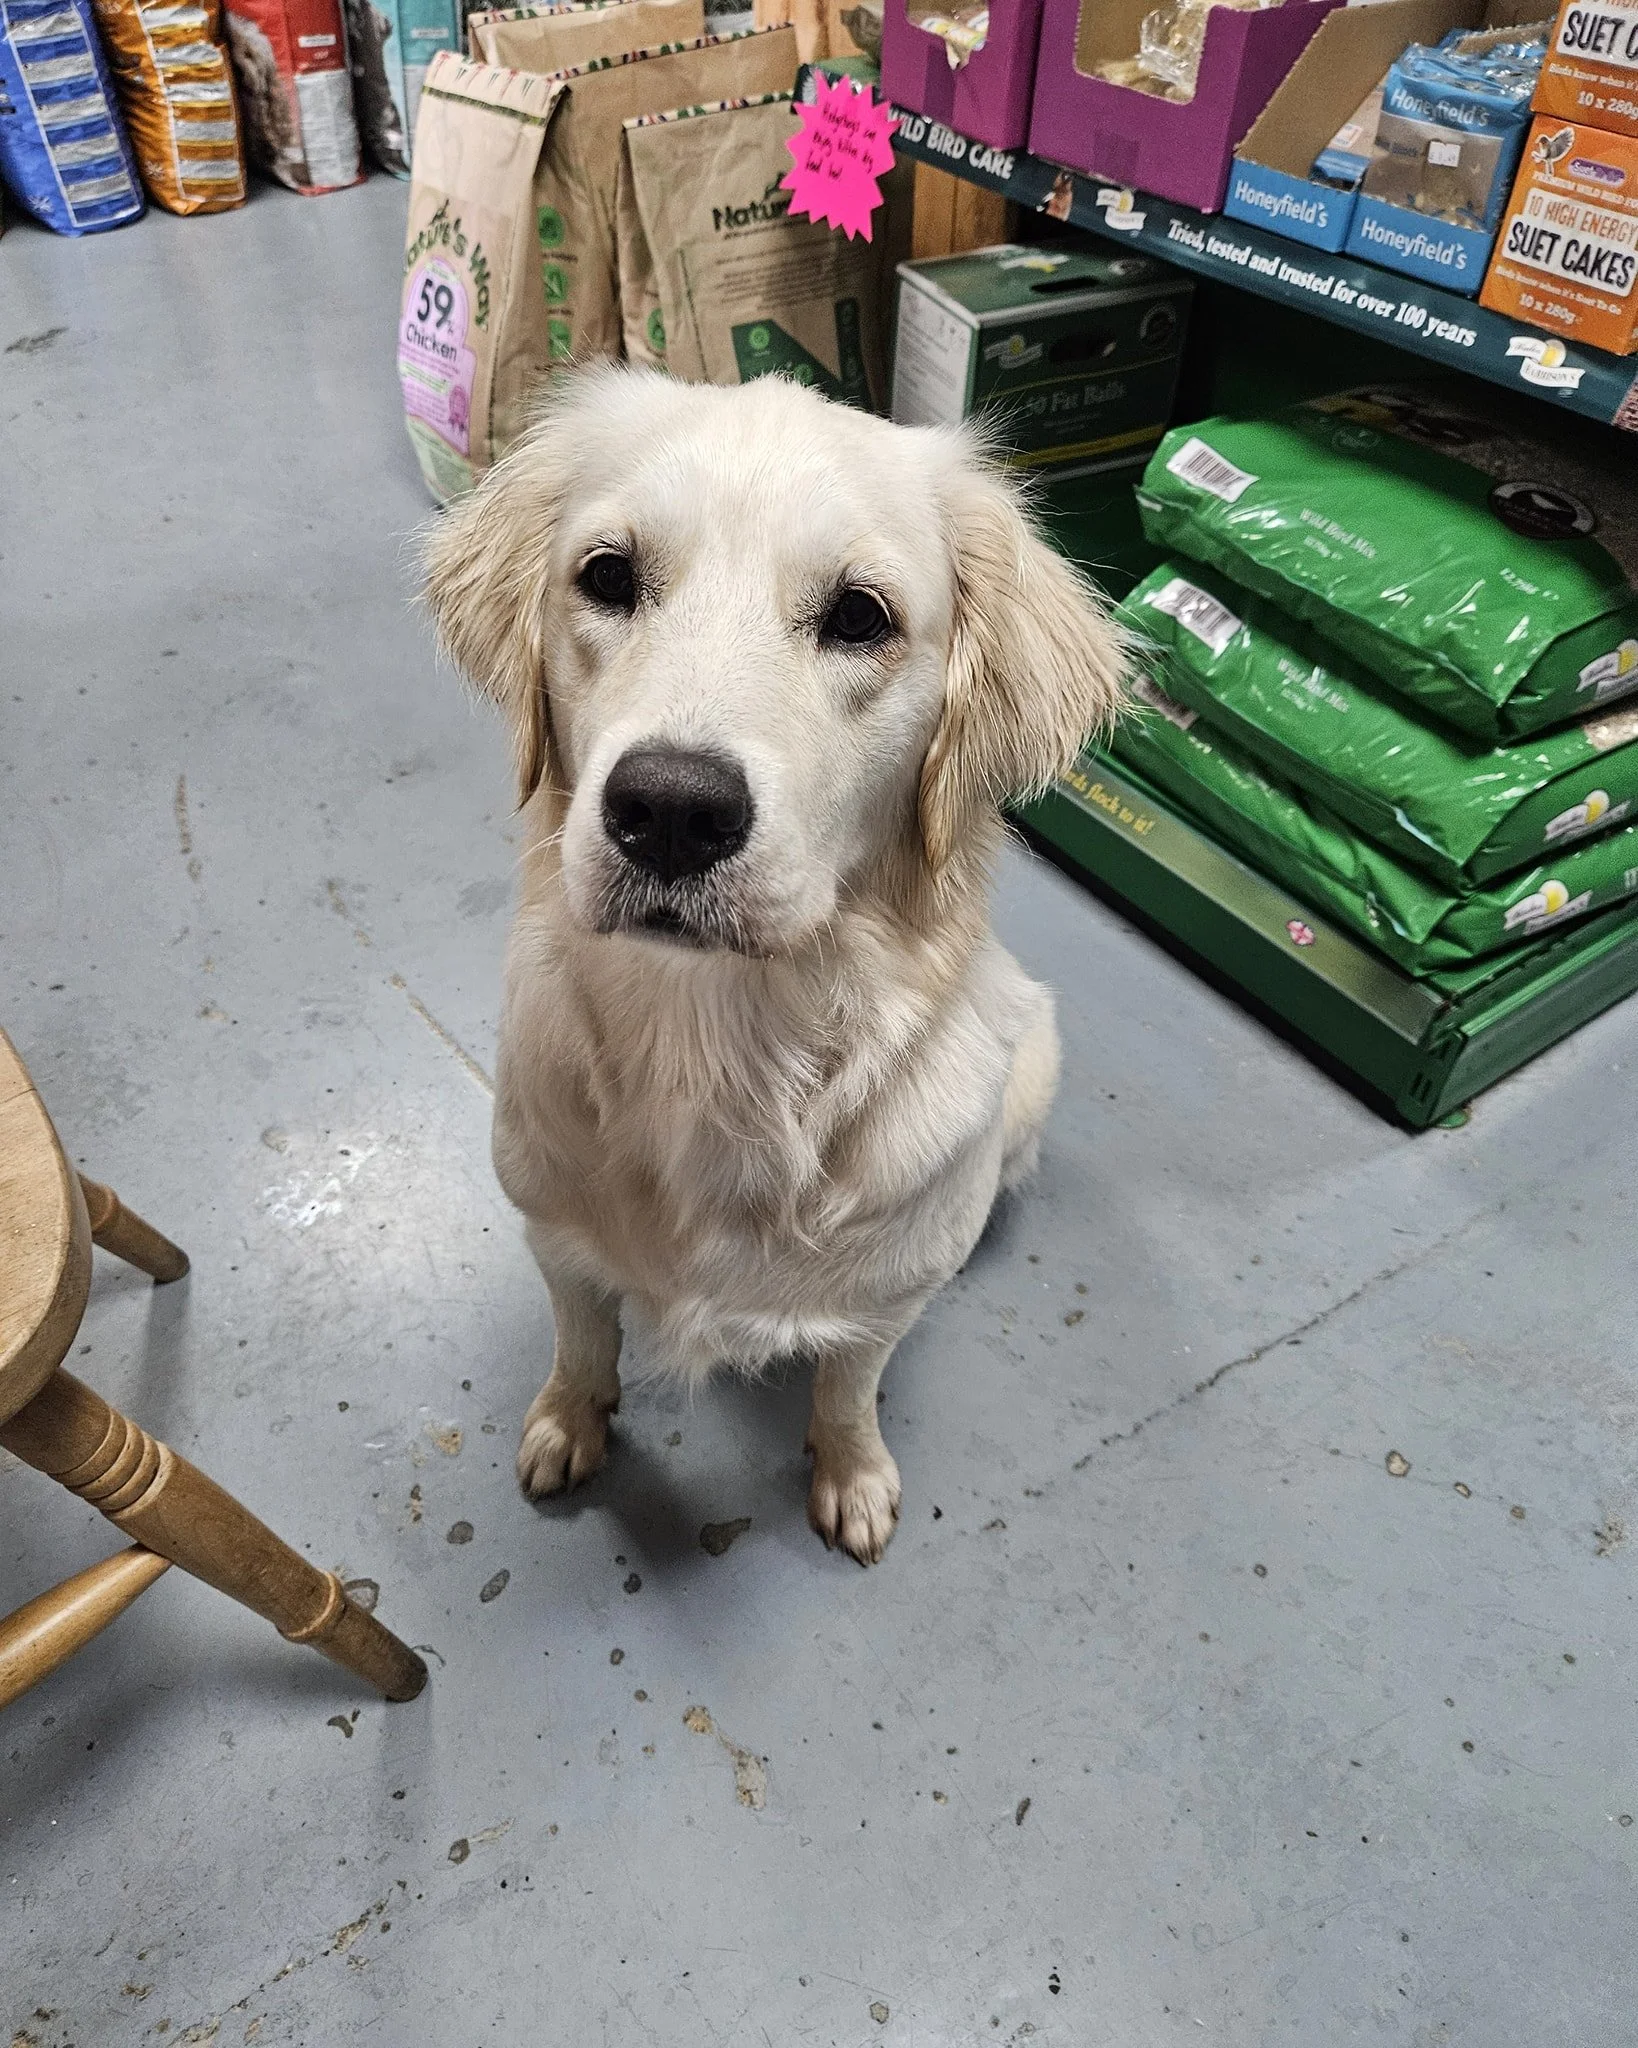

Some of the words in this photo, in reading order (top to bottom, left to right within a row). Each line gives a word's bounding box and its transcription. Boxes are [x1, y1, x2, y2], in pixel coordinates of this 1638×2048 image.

[1563, 10, 1626, 54] SUET
[1391, 88, 1491, 127] Honeyfield's
[1577, 90, 1595, 106] 10
[1595, 97, 1606, 109] x
[887, 107, 925, 143] WILD
[926, 122, 967, 160] BIRD
[968, 143, 1016, 180] CARE
[1234, 179, 1329, 228] Honeyfield's
[1529, 194, 1543, 217] 10
[1544, 198, 1578, 229] HIGH
[1579, 210, 1638, 246] ENERGY
[1360, 217, 1468, 271] Honeyfield's
[1508, 221, 1562, 265] SUET
[1561, 238, 1635, 289] CAKES
[1167, 218, 1205, 253] Tried,
[1206, 236, 1252, 266] tested
[1249, 253, 1282, 277] and
[1278, 261, 1335, 297] trusted
[1331, 278, 1359, 305] for
[1356, 292, 1396, 318] over
[1394, 302, 1428, 329] 100
[1422, 315, 1478, 347] years
[1519, 293, 1534, 309] 10
[1534, 299, 1544, 312] x
[1544, 301, 1577, 325] 280g
[406, 323, 458, 363] Chicken
